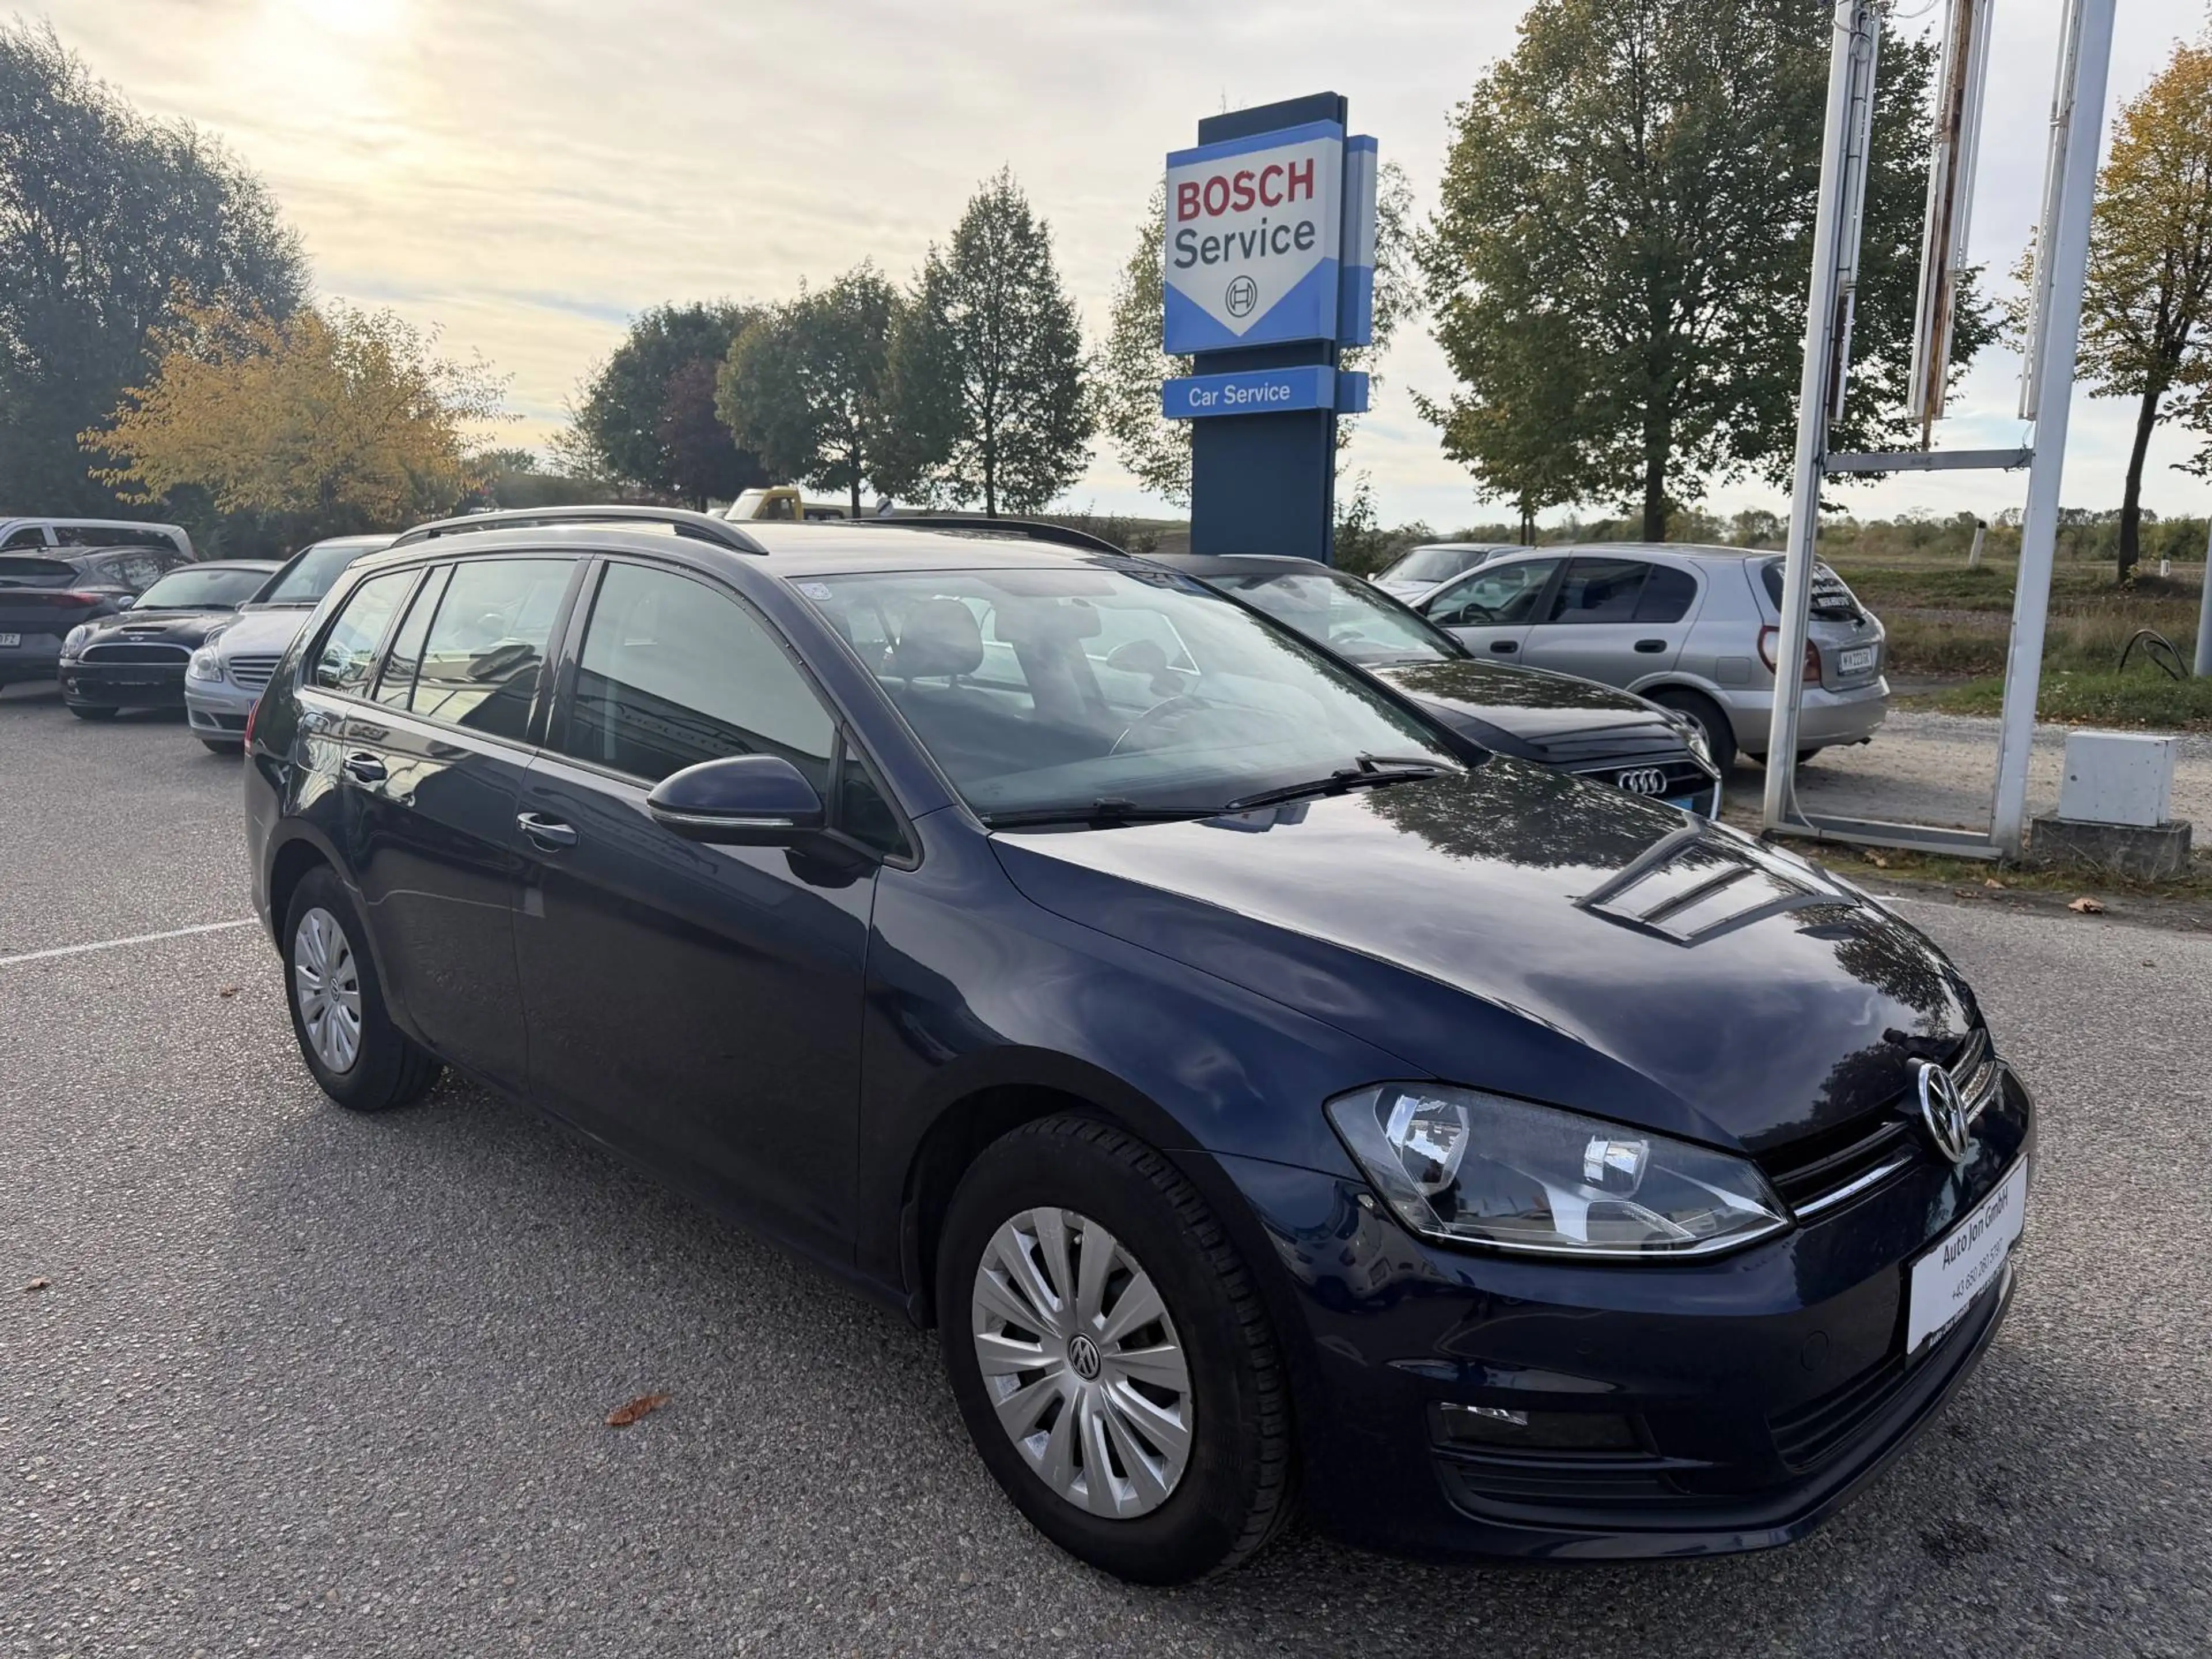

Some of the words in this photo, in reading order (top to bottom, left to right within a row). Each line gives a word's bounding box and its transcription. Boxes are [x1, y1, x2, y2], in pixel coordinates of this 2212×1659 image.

[1178, 158, 1313, 222] BOSCH
[1173, 217, 1316, 269] Service
[1189, 387, 1218, 407] Car
[1224, 381, 1290, 404] Service
[1942, 1234, 1967, 1271] Auto
[1968, 1218, 1984, 1251] Jon
[1985, 1185, 2008, 1229] GmbH
